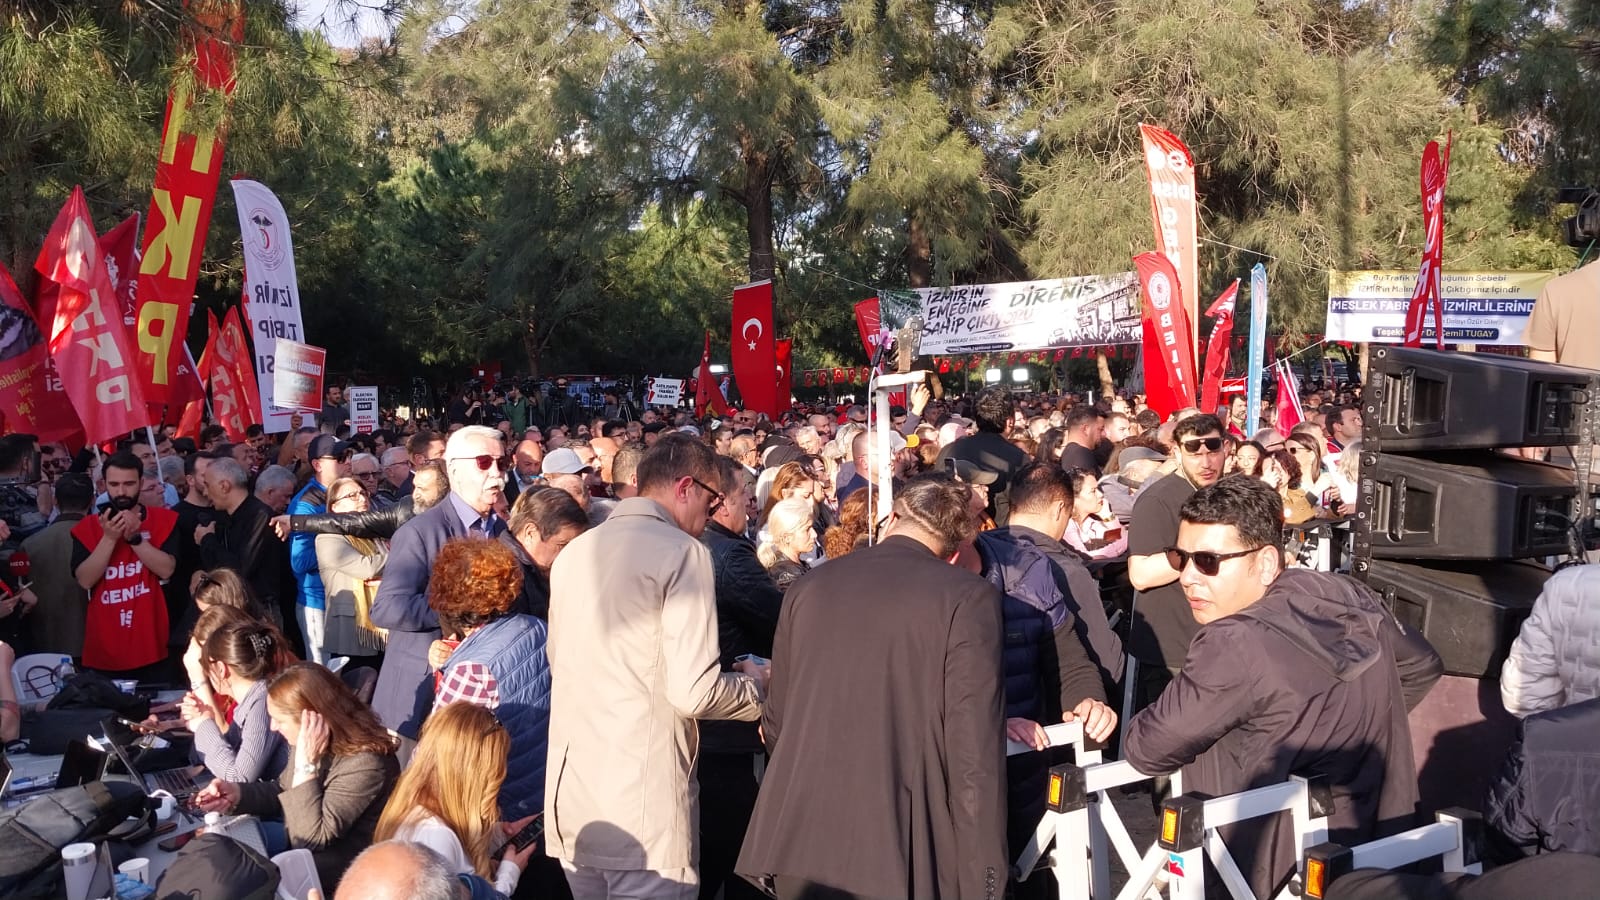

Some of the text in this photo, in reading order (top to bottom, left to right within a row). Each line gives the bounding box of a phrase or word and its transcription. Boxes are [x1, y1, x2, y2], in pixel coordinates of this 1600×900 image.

[1332, 300, 1379, 310] MESLEK
[1466, 329, 1494, 337] TUGAY
[101, 582, 149, 604] GENEL
